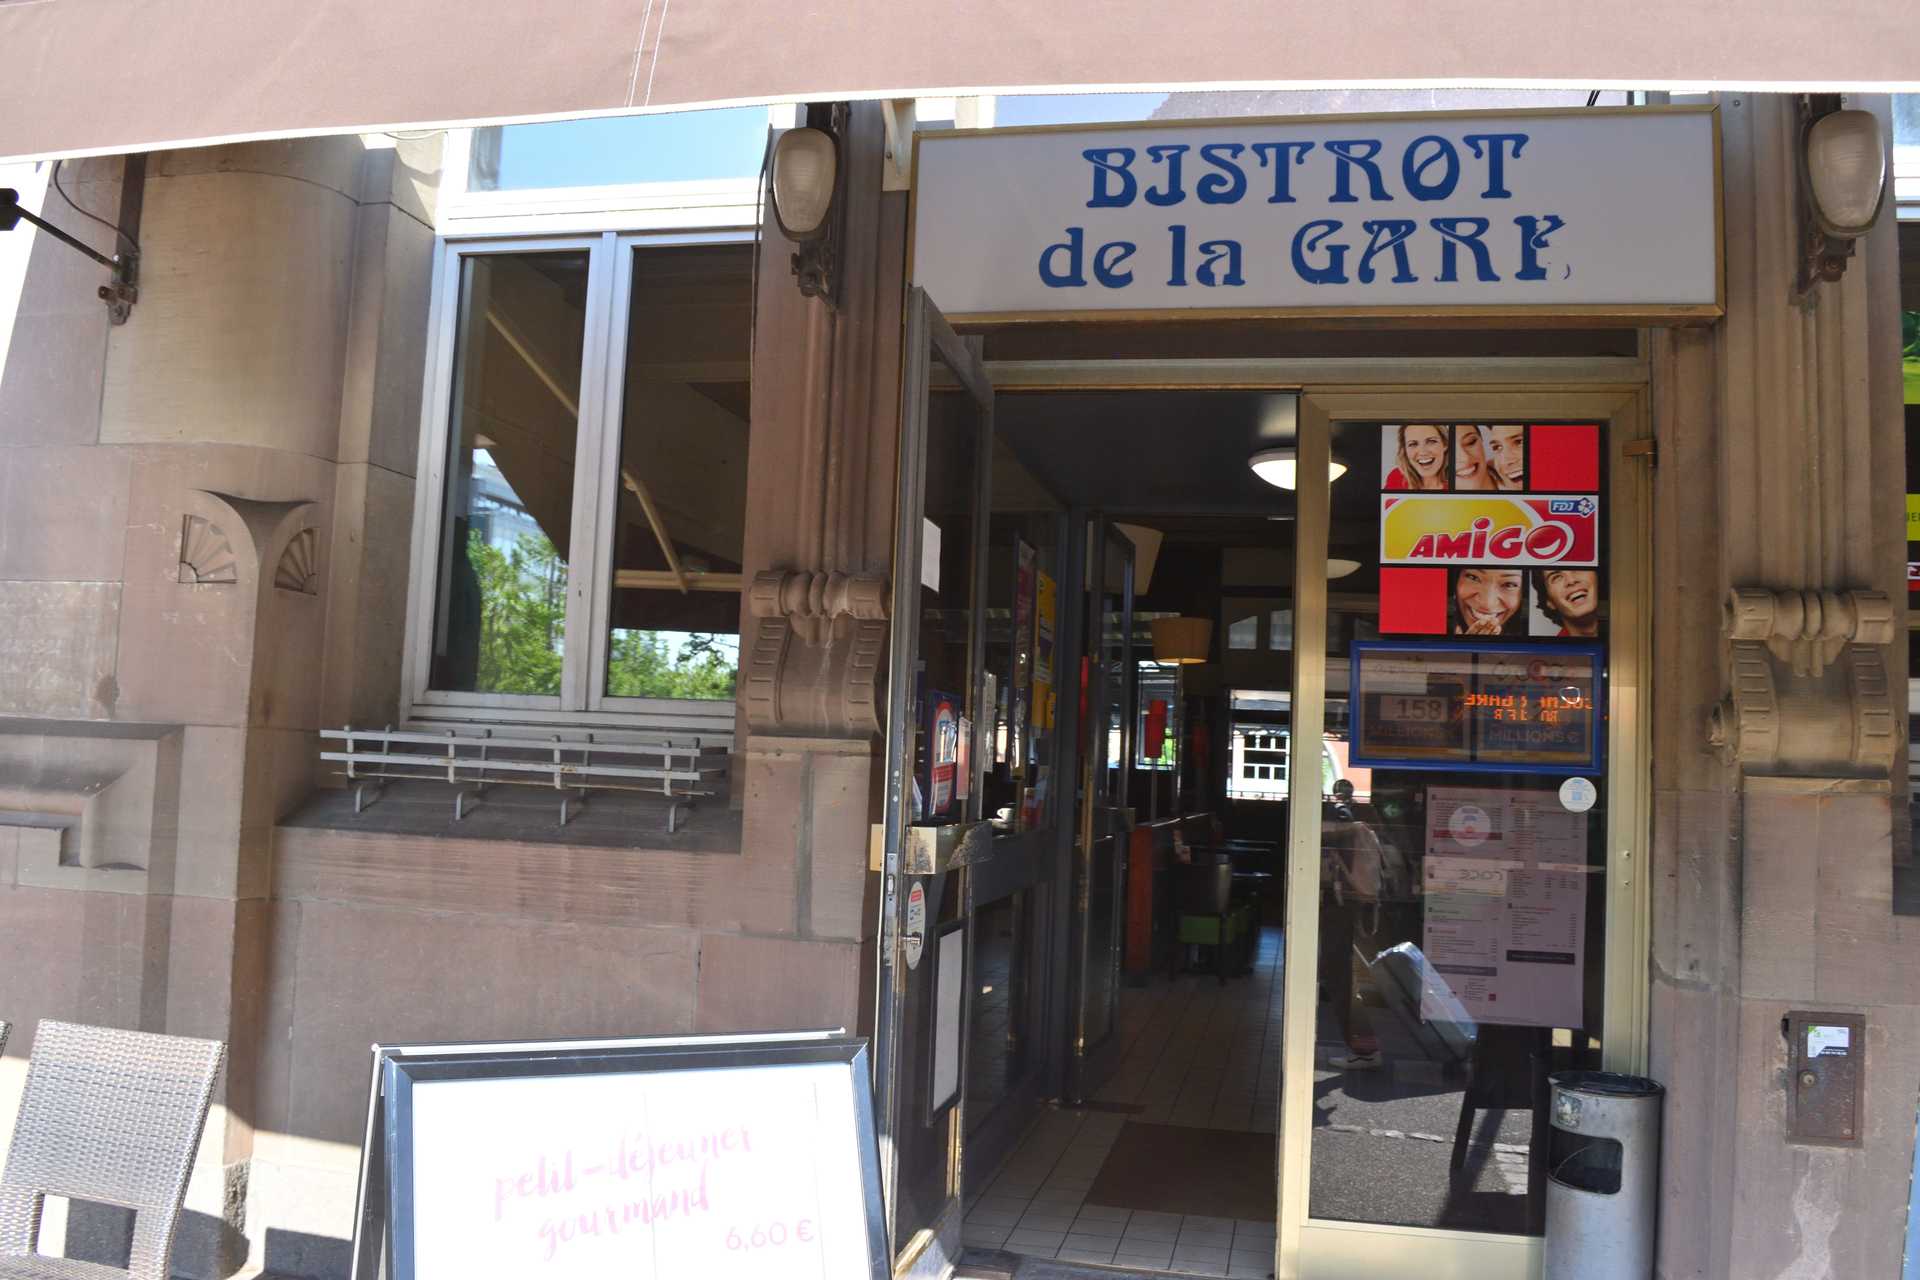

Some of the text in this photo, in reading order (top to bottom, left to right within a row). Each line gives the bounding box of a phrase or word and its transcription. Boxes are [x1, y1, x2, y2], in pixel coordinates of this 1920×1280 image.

[1082, 133, 1529, 208] BISTROT
[1039, 226, 1137, 288] de
[1167, 224, 1246, 287] la
[1551, 501, 1575, 513] FDJ
[538, 1160, 711, 1262] gourmand
[725, 1219, 816, 1253] 6,60 €
